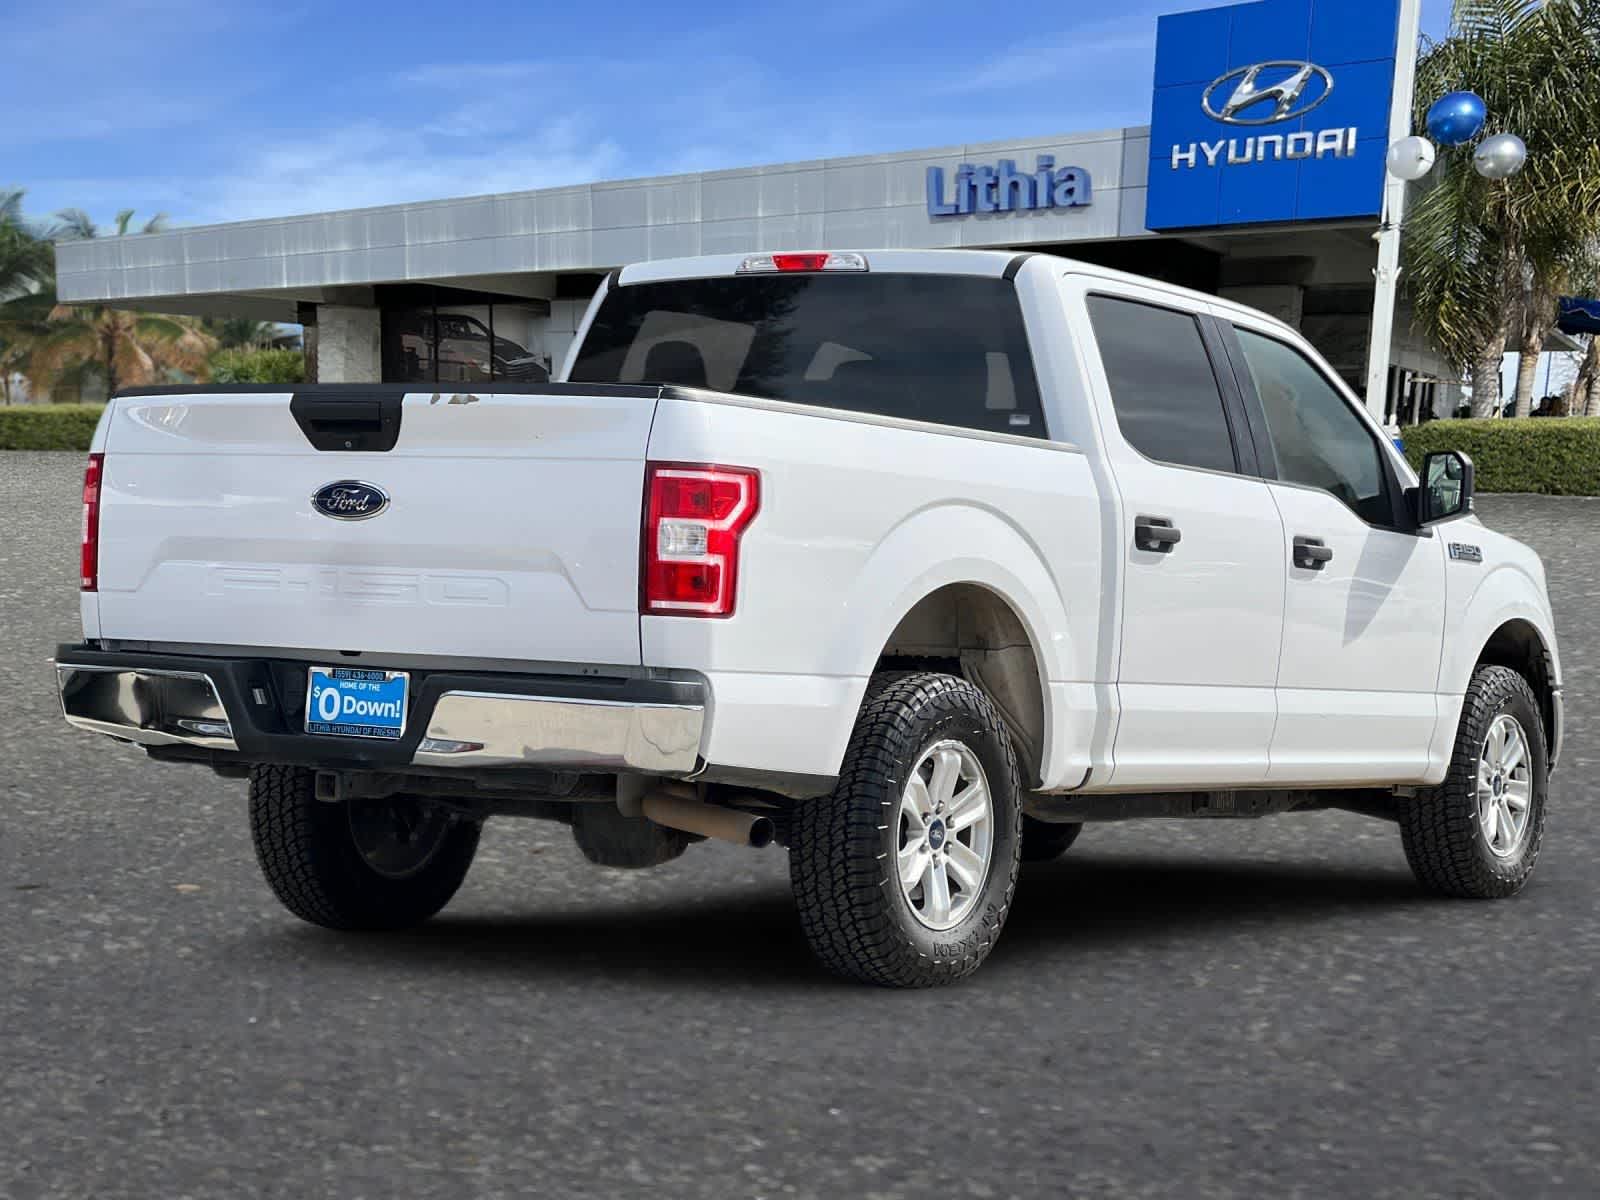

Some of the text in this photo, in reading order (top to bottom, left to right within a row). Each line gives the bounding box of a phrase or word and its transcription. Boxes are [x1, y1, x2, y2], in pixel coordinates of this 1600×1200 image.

[1171, 127, 1357, 169] HYUNDAI
[926, 155, 1092, 217] Lithia
[327, 487, 370, 511] Ford
[340, 681, 381, 692] HOME OF THE
[343, 695, 401, 718] Down!
[309, 723, 331, 733] LITHIA
[331, 724, 362, 735] HYUNDAI
[363, 727, 373, 736] OF
